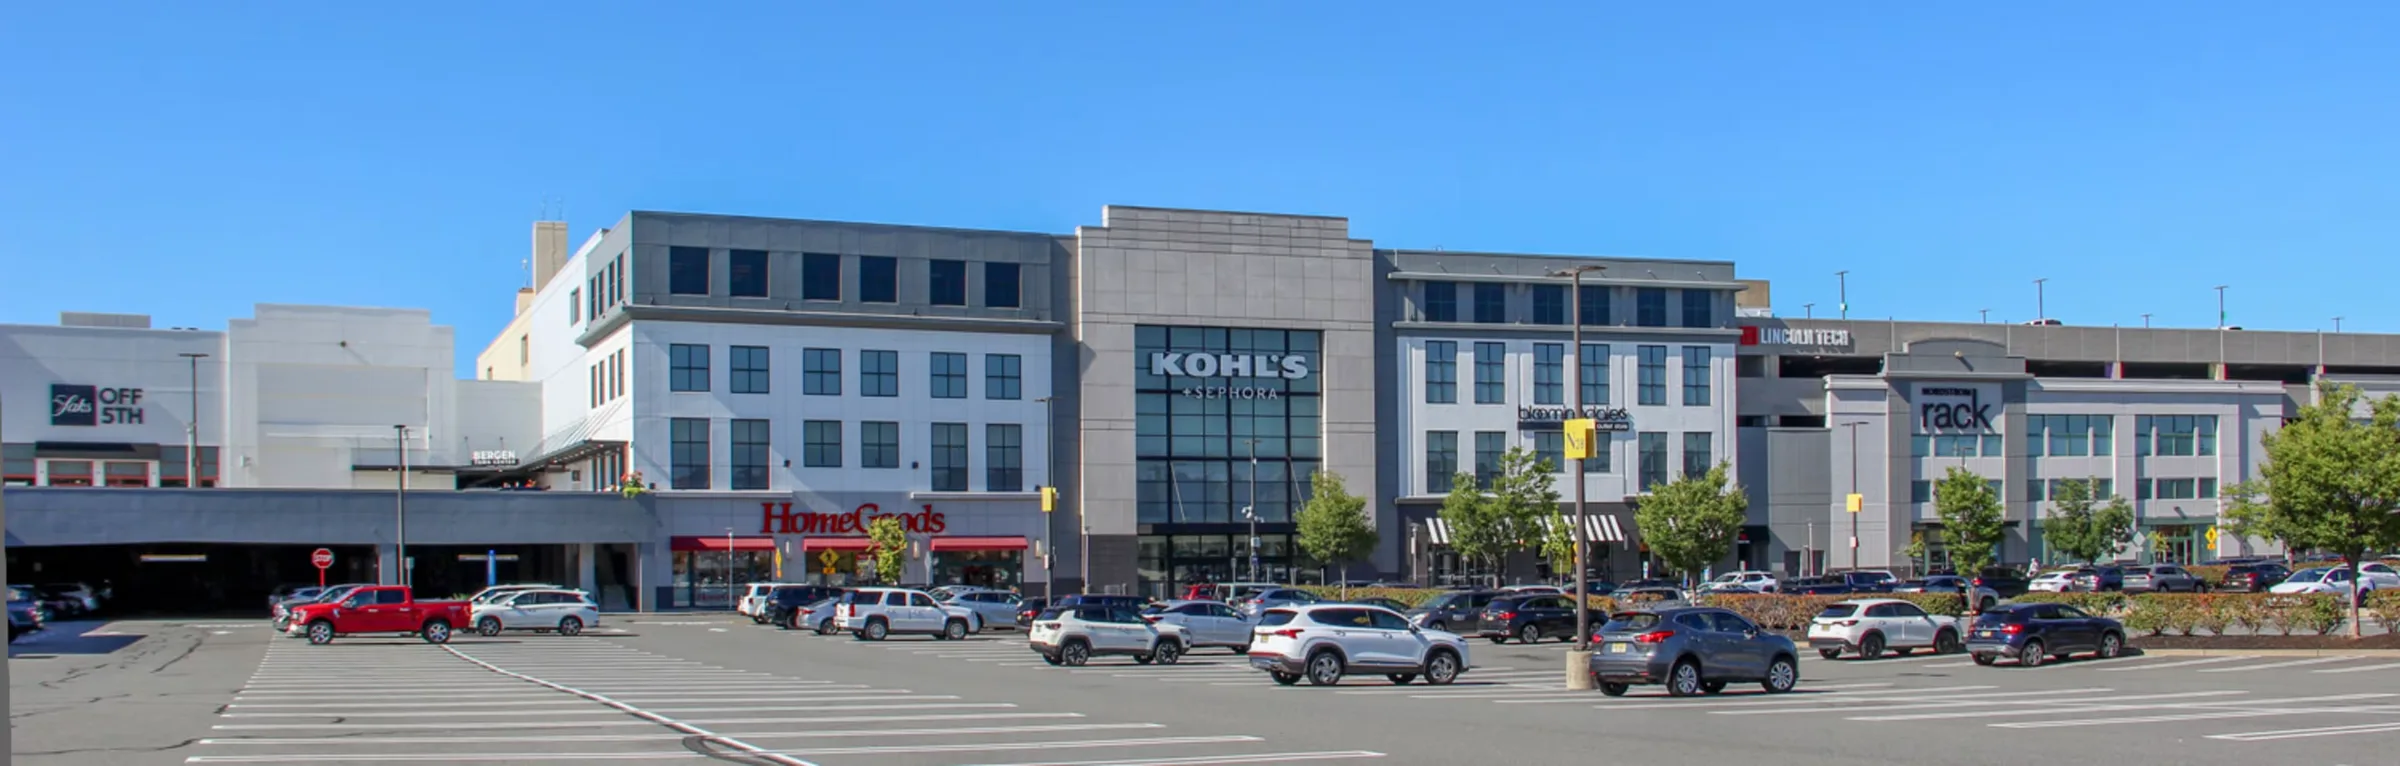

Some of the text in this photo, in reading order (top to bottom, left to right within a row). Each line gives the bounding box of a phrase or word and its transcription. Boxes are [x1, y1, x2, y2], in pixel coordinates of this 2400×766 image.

[1760, 328, 1848, 346] LINCOLN TECH
[1151, 352, 1308, 379] KOHL'S
[52, 394, 93, 417] Saks
[99, 387, 143, 405] OFF
[101, 407, 144, 424] 5TH
[1922, 388, 1992, 428] rack
[472, 450, 516, 460] BERGEN
[760, 503, 945, 534] HomeGods
